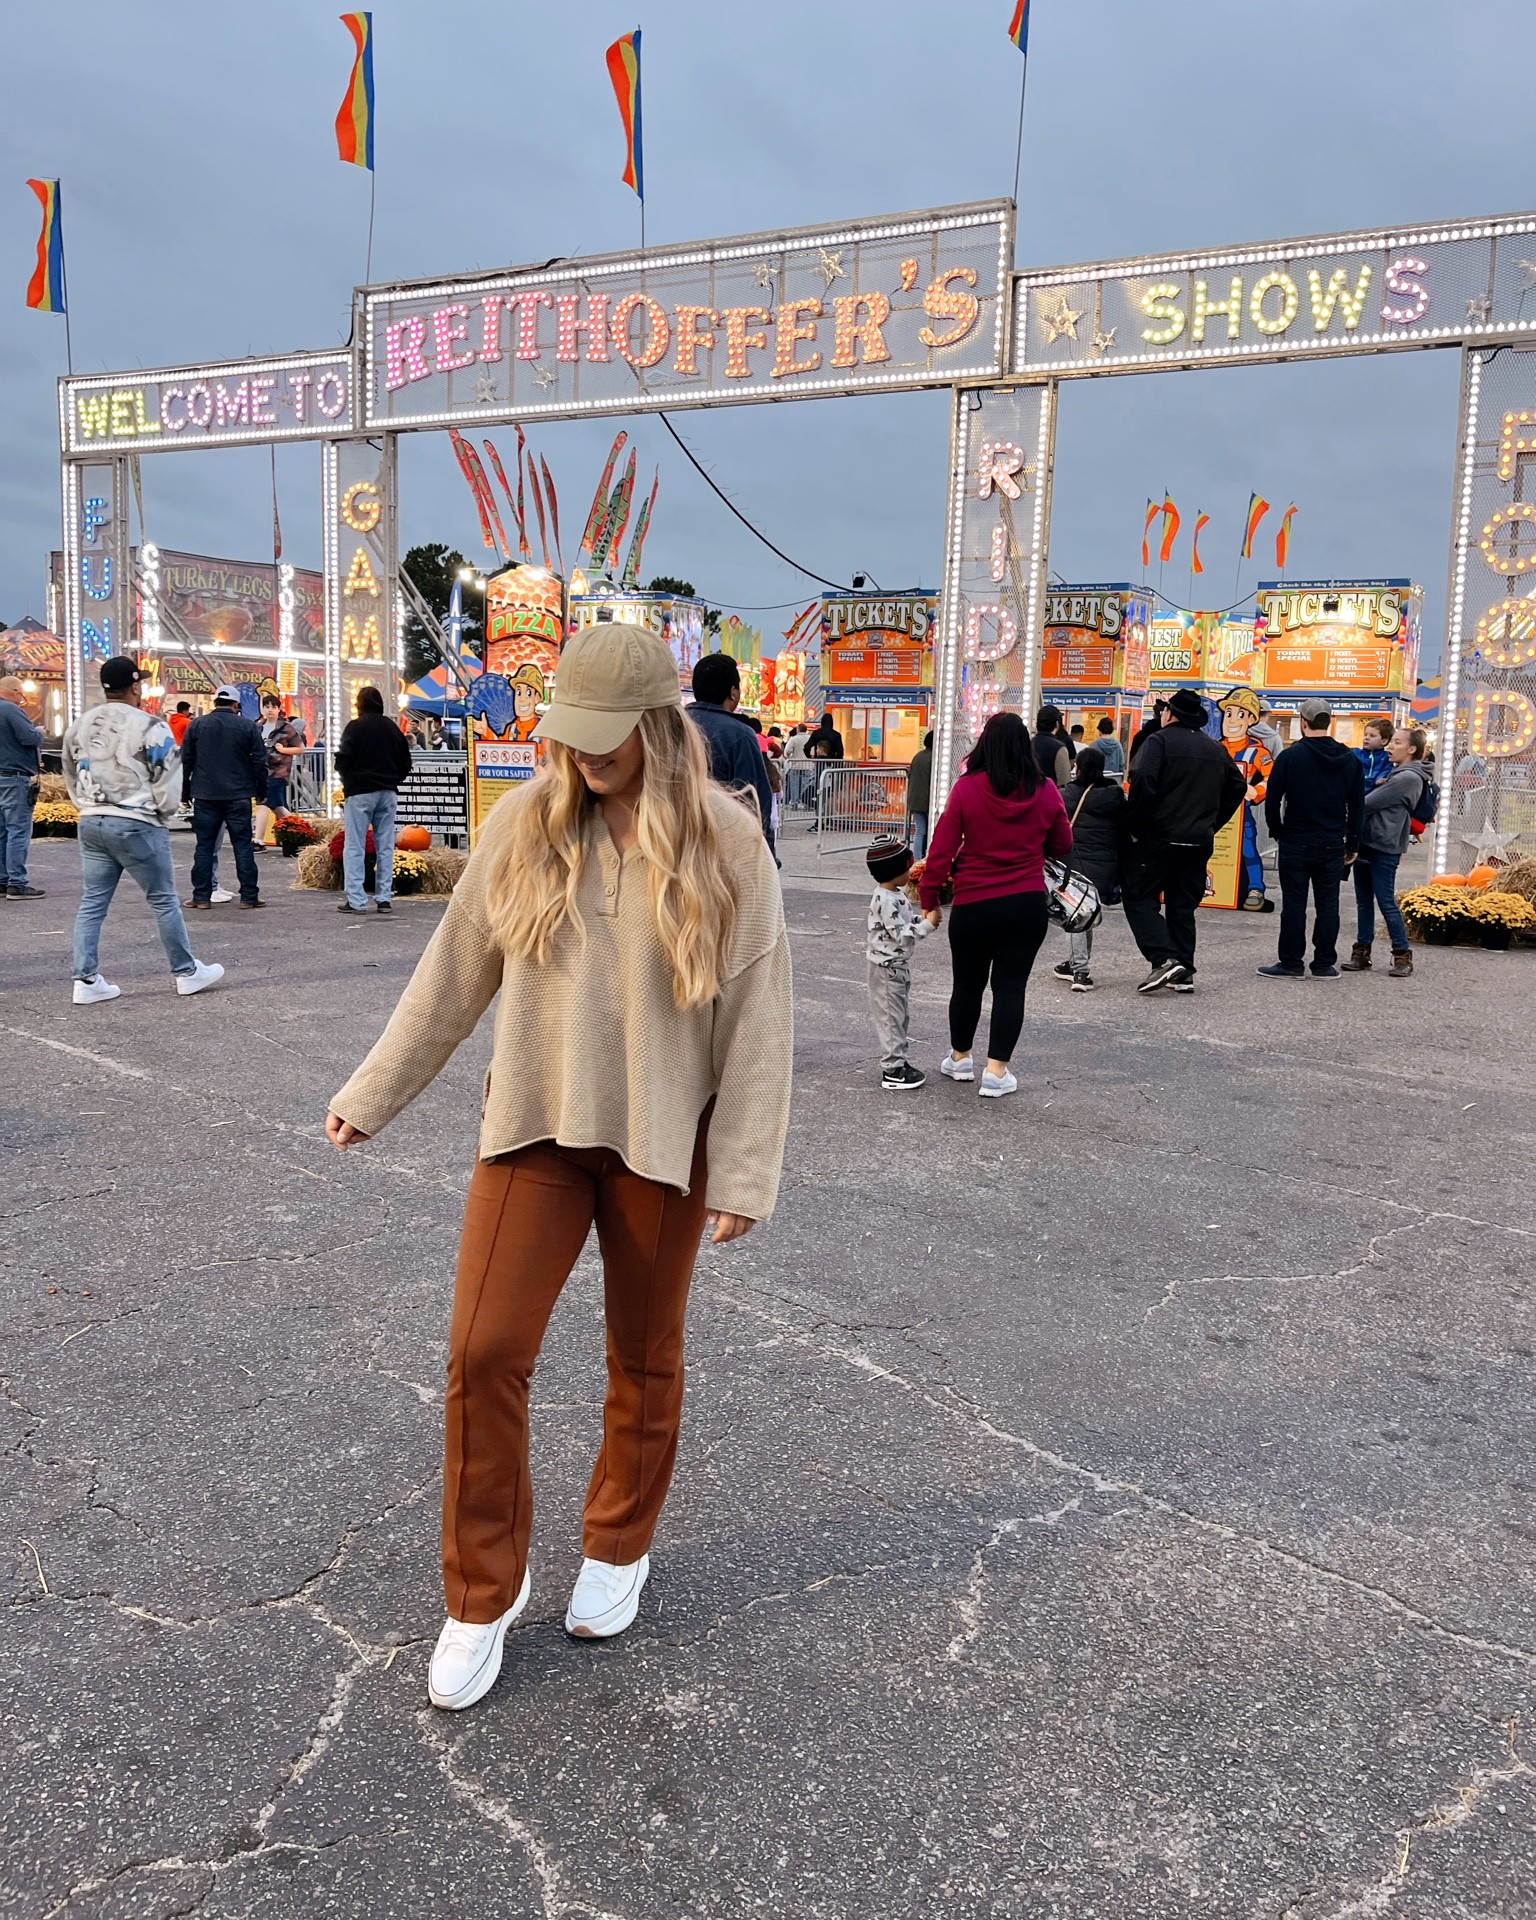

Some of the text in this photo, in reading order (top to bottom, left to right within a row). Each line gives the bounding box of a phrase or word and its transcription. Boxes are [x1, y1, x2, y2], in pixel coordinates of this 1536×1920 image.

[1140, 258, 1430, 344] SHOWS
[384, 258, 979, 391] REITHOFFER'S
[77, 371, 346, 439] WELCOME TO
[81, 497, 113, 661] FUN
[163, 567, 272, 600] TURKEY LEGS
[963, 440, 1024, 737] RIDE
[491, 611, 557, 641] PIZZA
[827, 601, 929, 637] TICKETS
[1264, 591, 1400, 635] TICKETS
[1150, 650, 1191, 670] VICES
[177, 680, 211, 692] LEGS
[478, 768, 533, 779] FOR YOUR SAFETY
